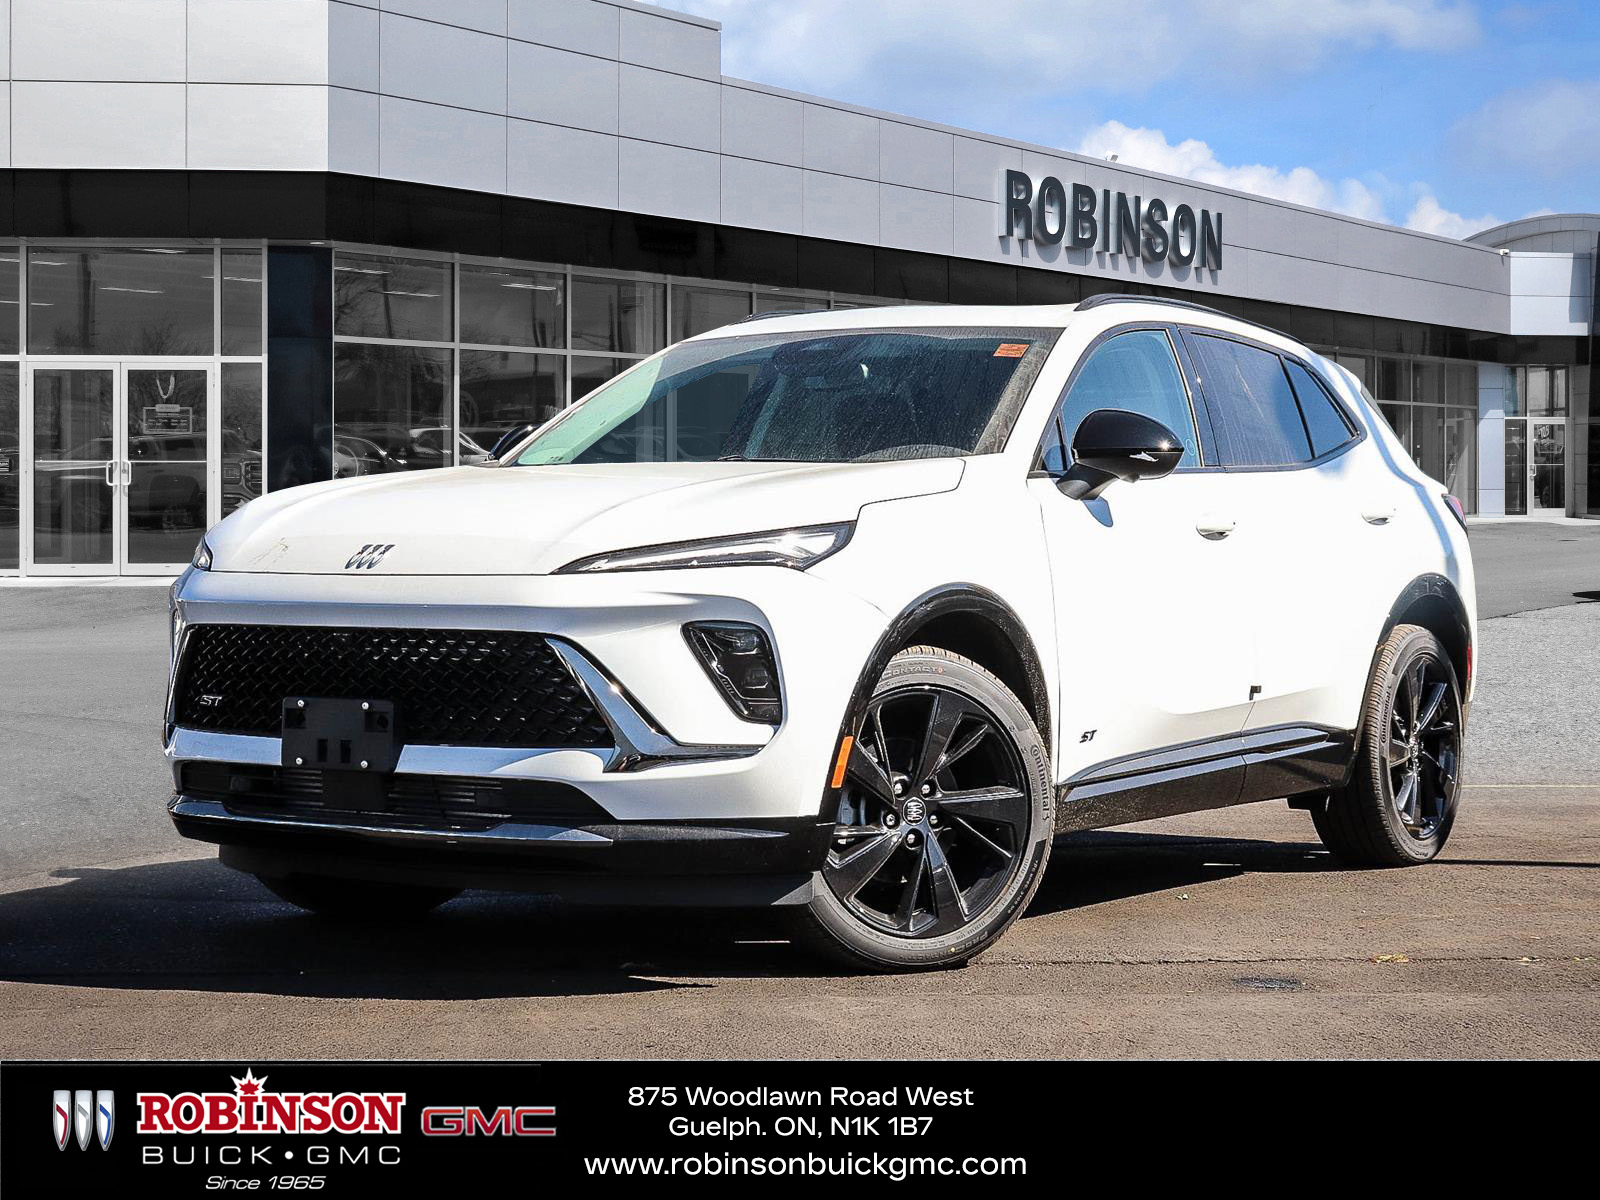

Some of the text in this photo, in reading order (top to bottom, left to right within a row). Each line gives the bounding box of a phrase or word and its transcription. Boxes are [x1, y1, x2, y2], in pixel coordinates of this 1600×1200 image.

[1001, 169, 1222, 271] ROBINSON
[200, 695, 222, 706] ST
[1080, 729, 1097, 743] ST
[1030, 744, 1050, 811] Continental
